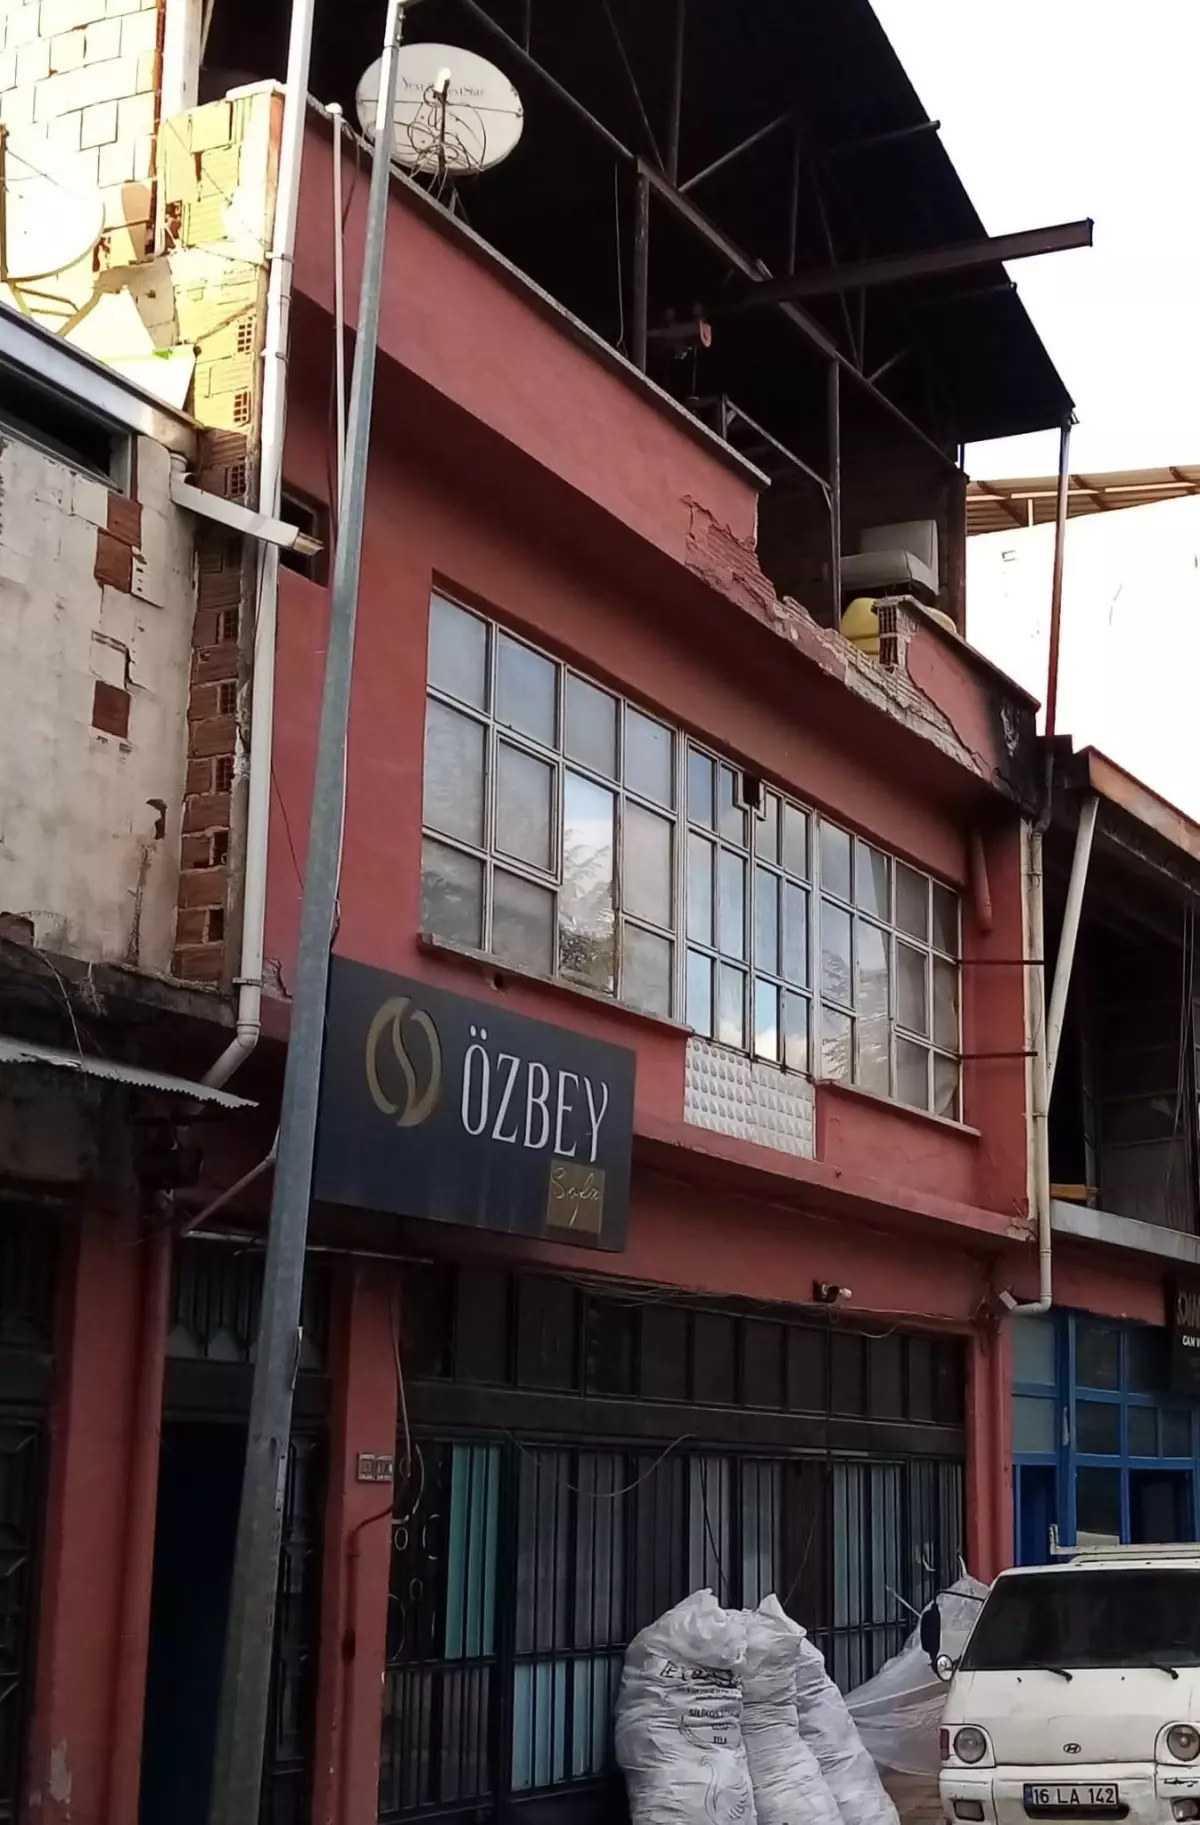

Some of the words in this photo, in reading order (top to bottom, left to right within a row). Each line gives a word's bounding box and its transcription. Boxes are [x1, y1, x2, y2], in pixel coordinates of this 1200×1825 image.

[461, 1025, 609, 1162] ÖZBEY
[1034, 1788, 1049, 1804] 16
[1057, 1788, 1080, 1804] LA
[1088, 1787, 1115, 1804] 142
